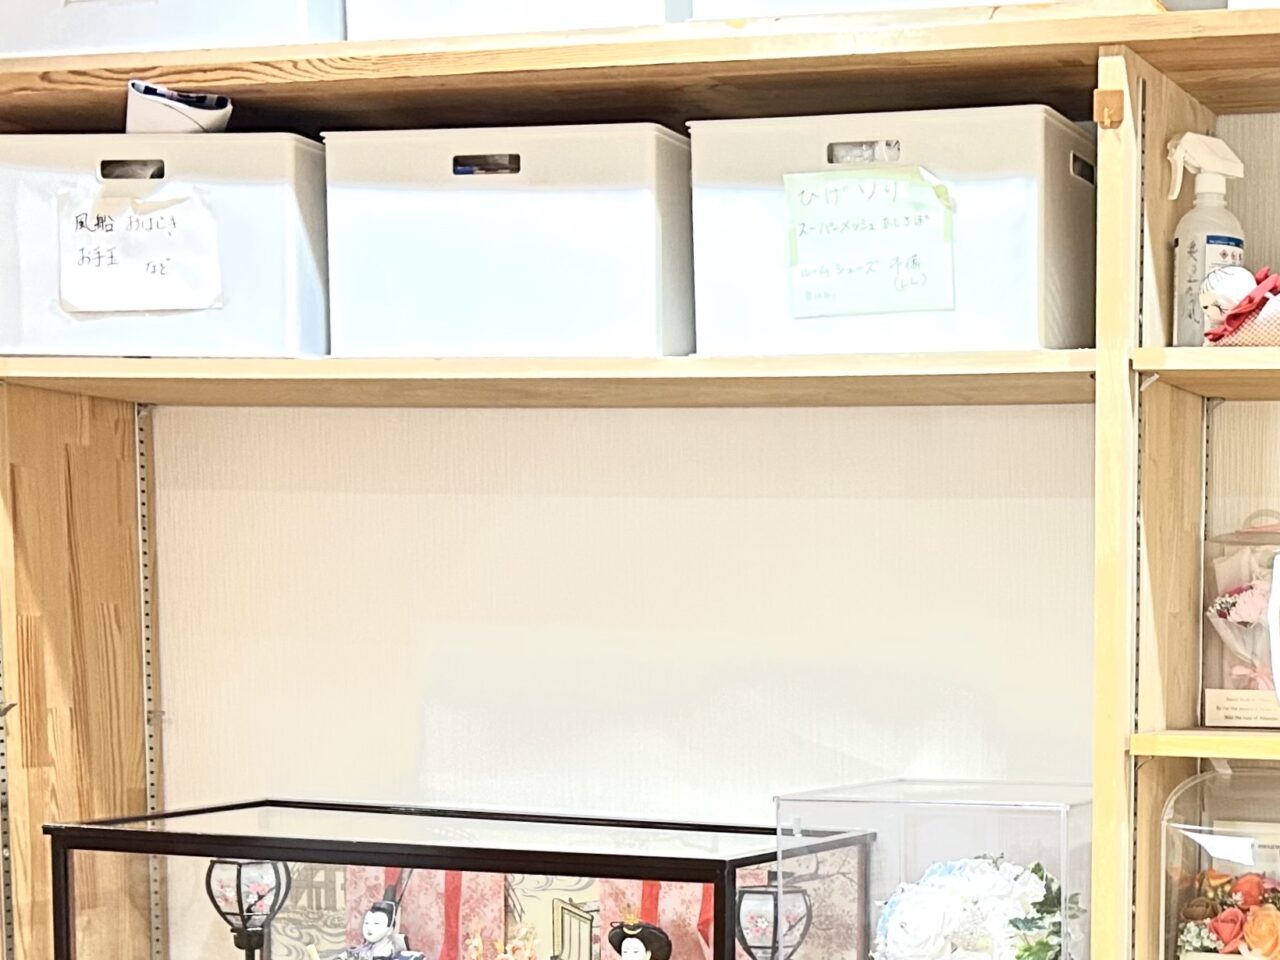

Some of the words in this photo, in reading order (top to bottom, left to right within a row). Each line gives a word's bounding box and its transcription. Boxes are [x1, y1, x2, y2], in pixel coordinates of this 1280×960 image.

[75, 212, 115, 233] 風船
[126, 215, 177, 237] おはじき
[77, 246, 119, 267] お手玉
[146, 258, 171, 276] など
